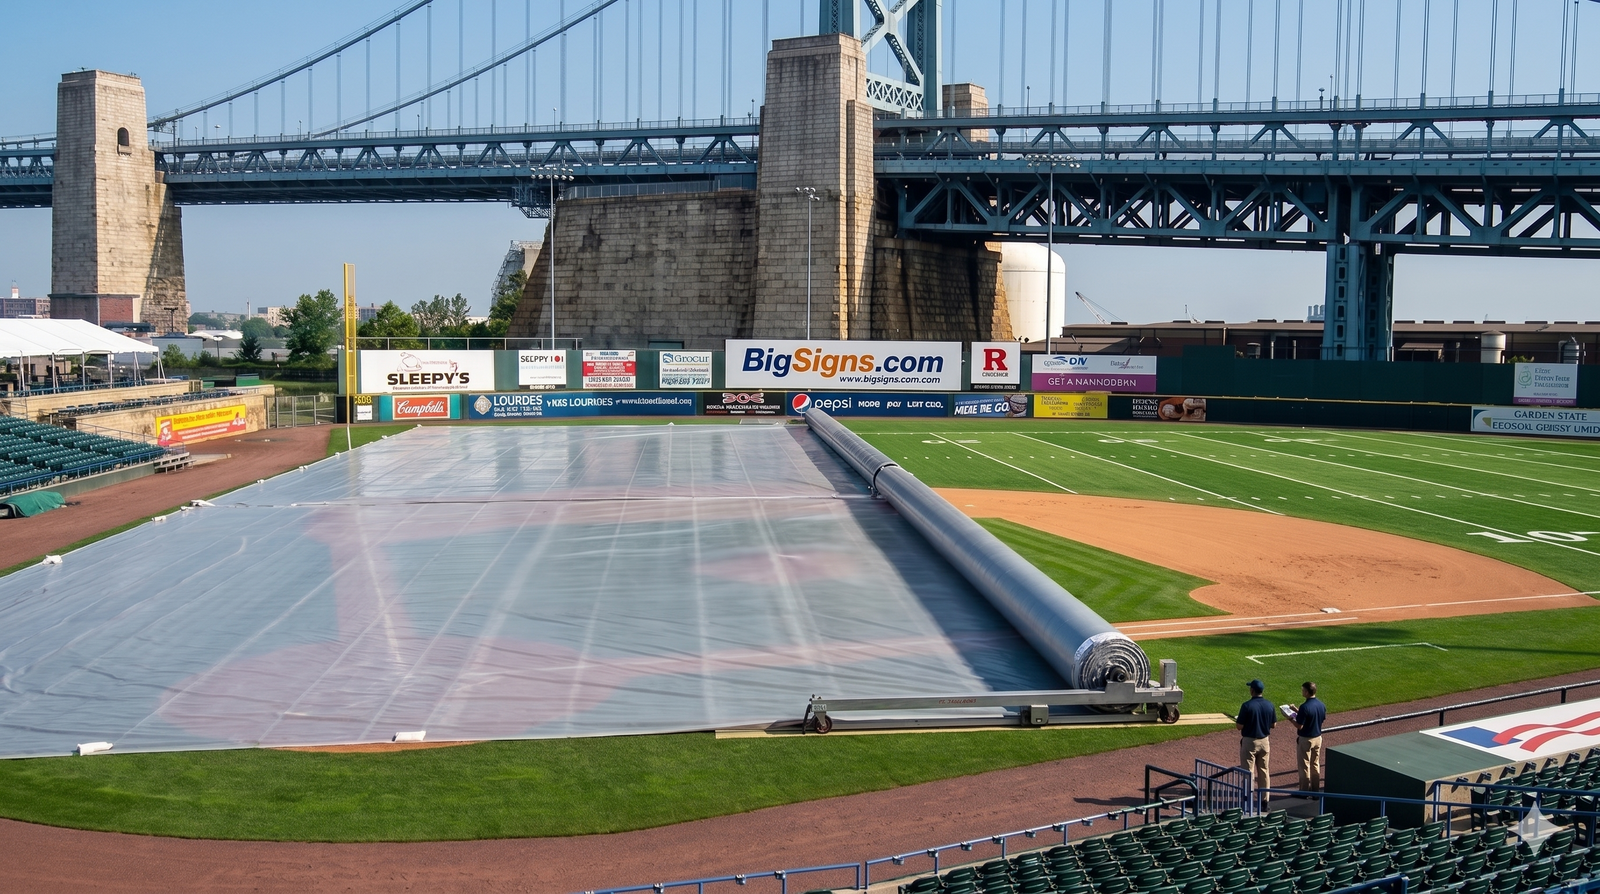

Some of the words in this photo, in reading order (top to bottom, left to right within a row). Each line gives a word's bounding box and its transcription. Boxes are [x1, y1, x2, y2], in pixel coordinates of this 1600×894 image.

[742, 347, 944, 378] BigSigns.com
[983, 348, 1008, 371] R
[387, 372, 470, 386] SLEEPY'S
[839, 374, 941, 385] www.bigsigns.com.com
[1047, 377, 1065, 386] GET
[1066, 378, 1074, 386] A
[493, 395, 543, 406] LOURDES
[814, 397, 852, 412] pepsi
[397, 400, 445, 417] Campbell's
[1514, 410, 1555, 419] GARDEN
[1557, 411, 1588, 421] STATE
